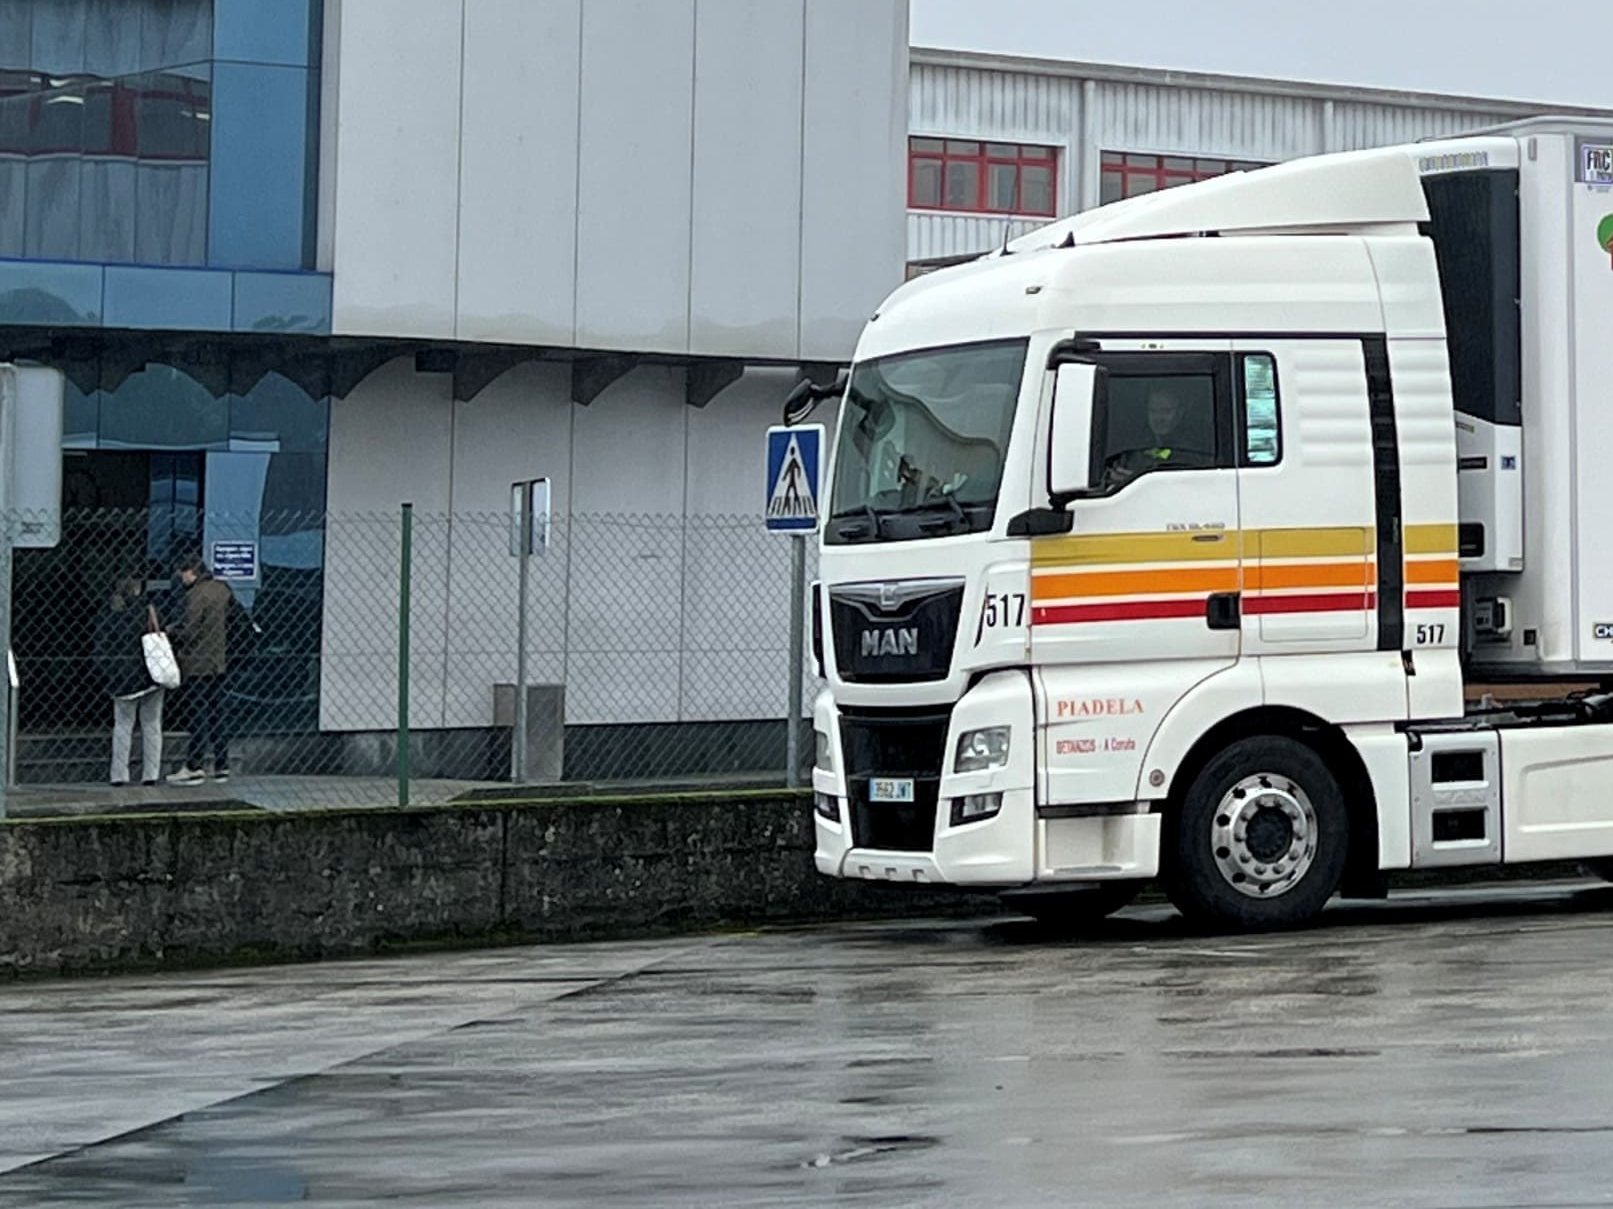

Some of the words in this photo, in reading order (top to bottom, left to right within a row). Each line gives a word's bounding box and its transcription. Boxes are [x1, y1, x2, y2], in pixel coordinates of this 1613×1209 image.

[986, 593, 1025, 627] 517
[861, 628, 918, 657] MAN
[1416, 623, 1445, 644] 517
[1057, 697, 1144, 717] PIADELA
